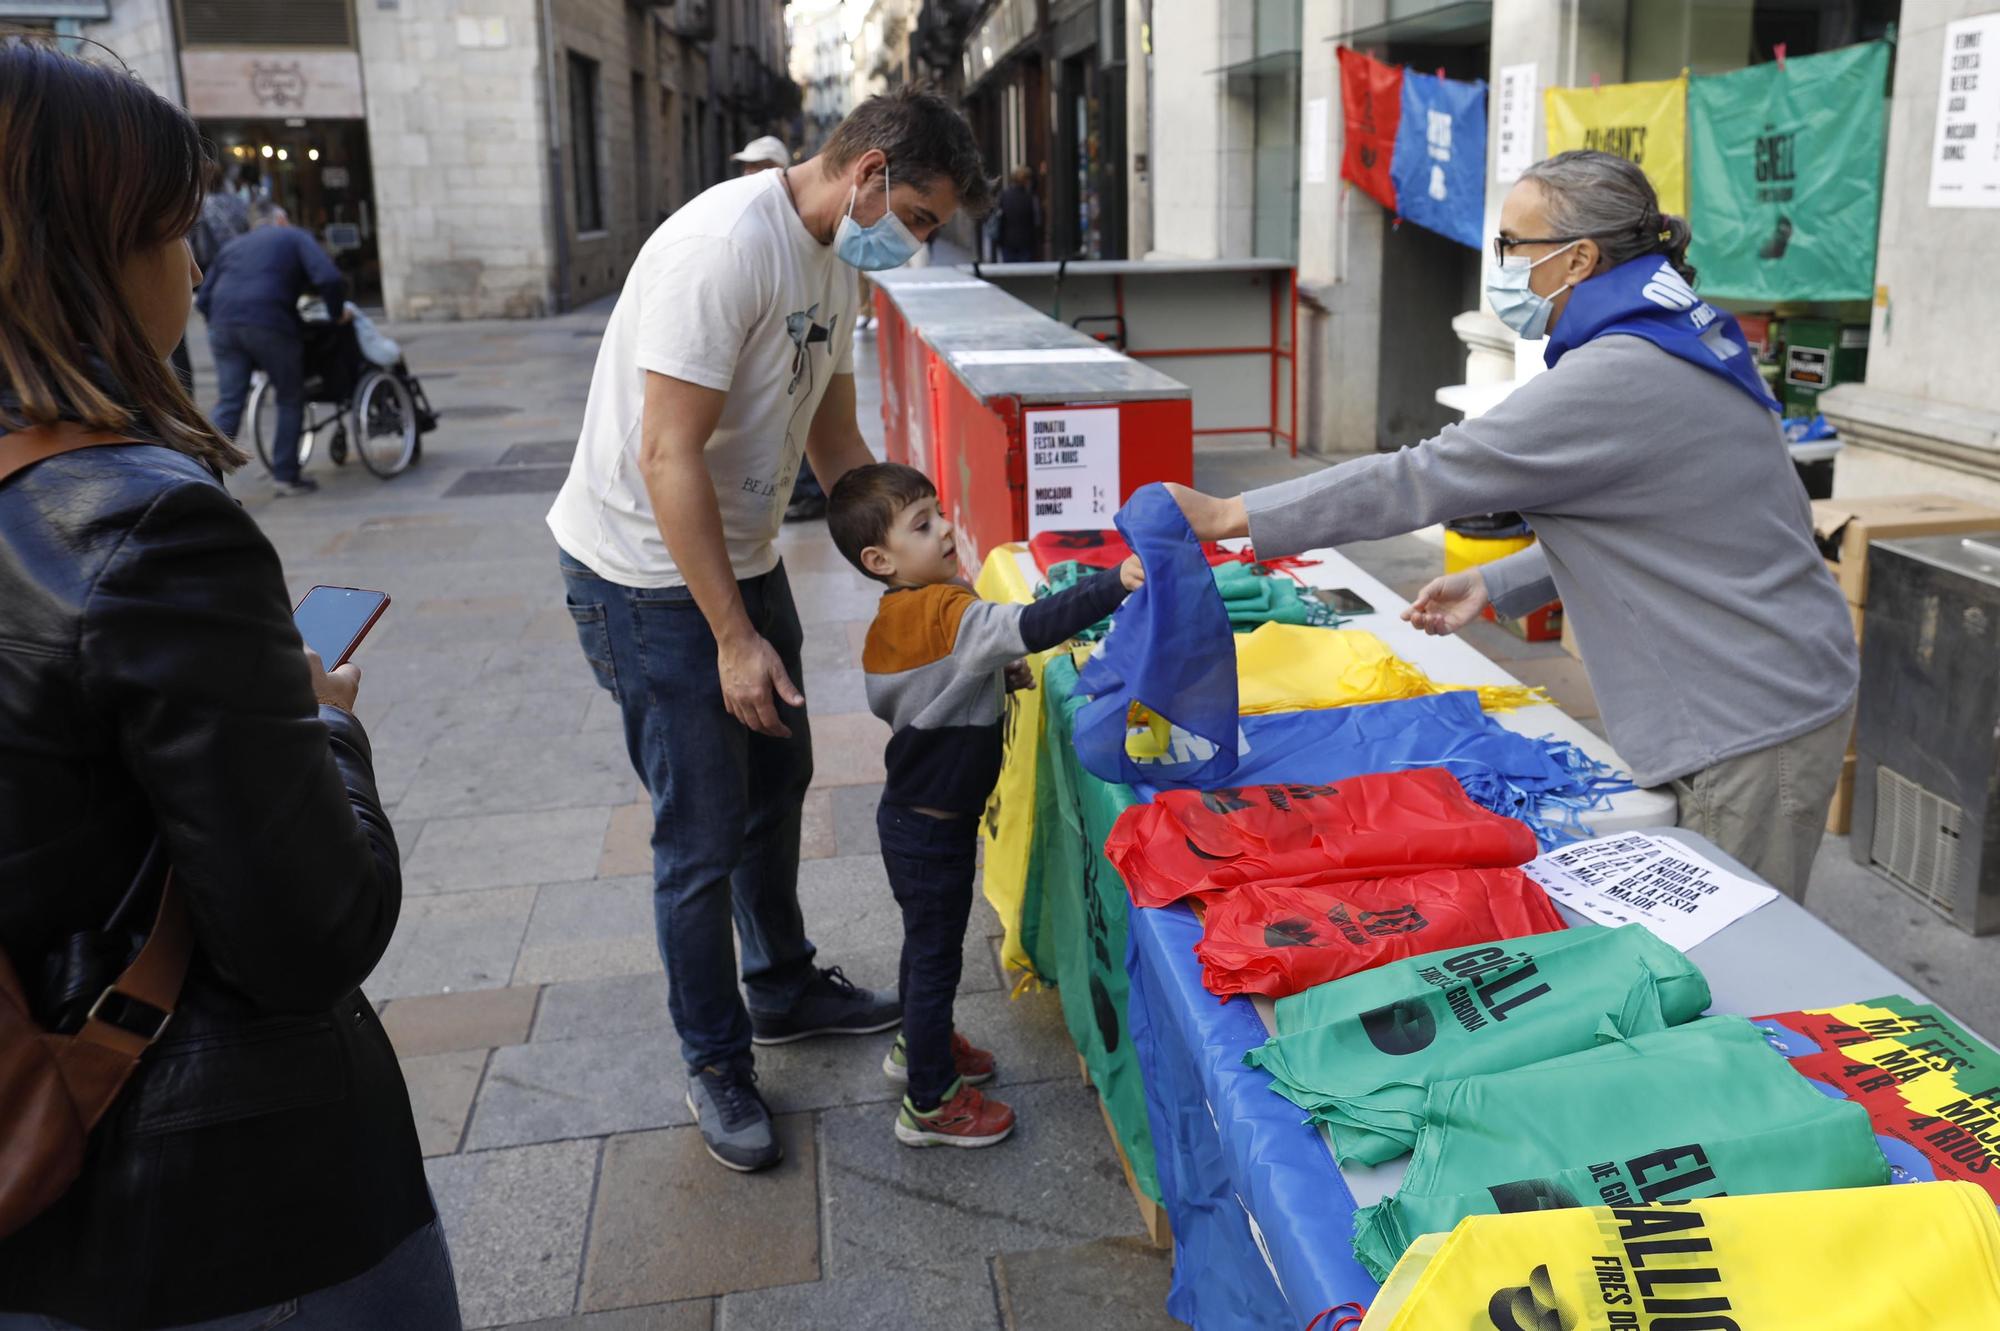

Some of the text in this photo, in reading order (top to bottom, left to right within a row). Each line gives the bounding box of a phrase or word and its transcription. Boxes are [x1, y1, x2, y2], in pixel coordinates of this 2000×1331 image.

[1033, 420, 1066, 434] DONATIU
[1033, 435, 1086, 450] FESTA MAJOR
[1034, 450, 1080, 466] DELS 4 RIUS
[1035, 486, 1072, 501] MOCADOR
[1632, 870, 1654, 882] LA
[1646, 863, 1720, 896] ENDUR PER
[1604, 885, 1658, 910] MAJOR
[1618, 877, 1642, 889] DE
[1637, 885, 1658, 897] LA
[1655, 893, 1699, 914] FESTA
[1445, 985, 1488, 1032] GIRONA
[1907, 1116, 1943, 1131] 4
[1923, 1126, 2000, 1174] RIUS
[1591, 1256, 1633, 1305] FIRES
